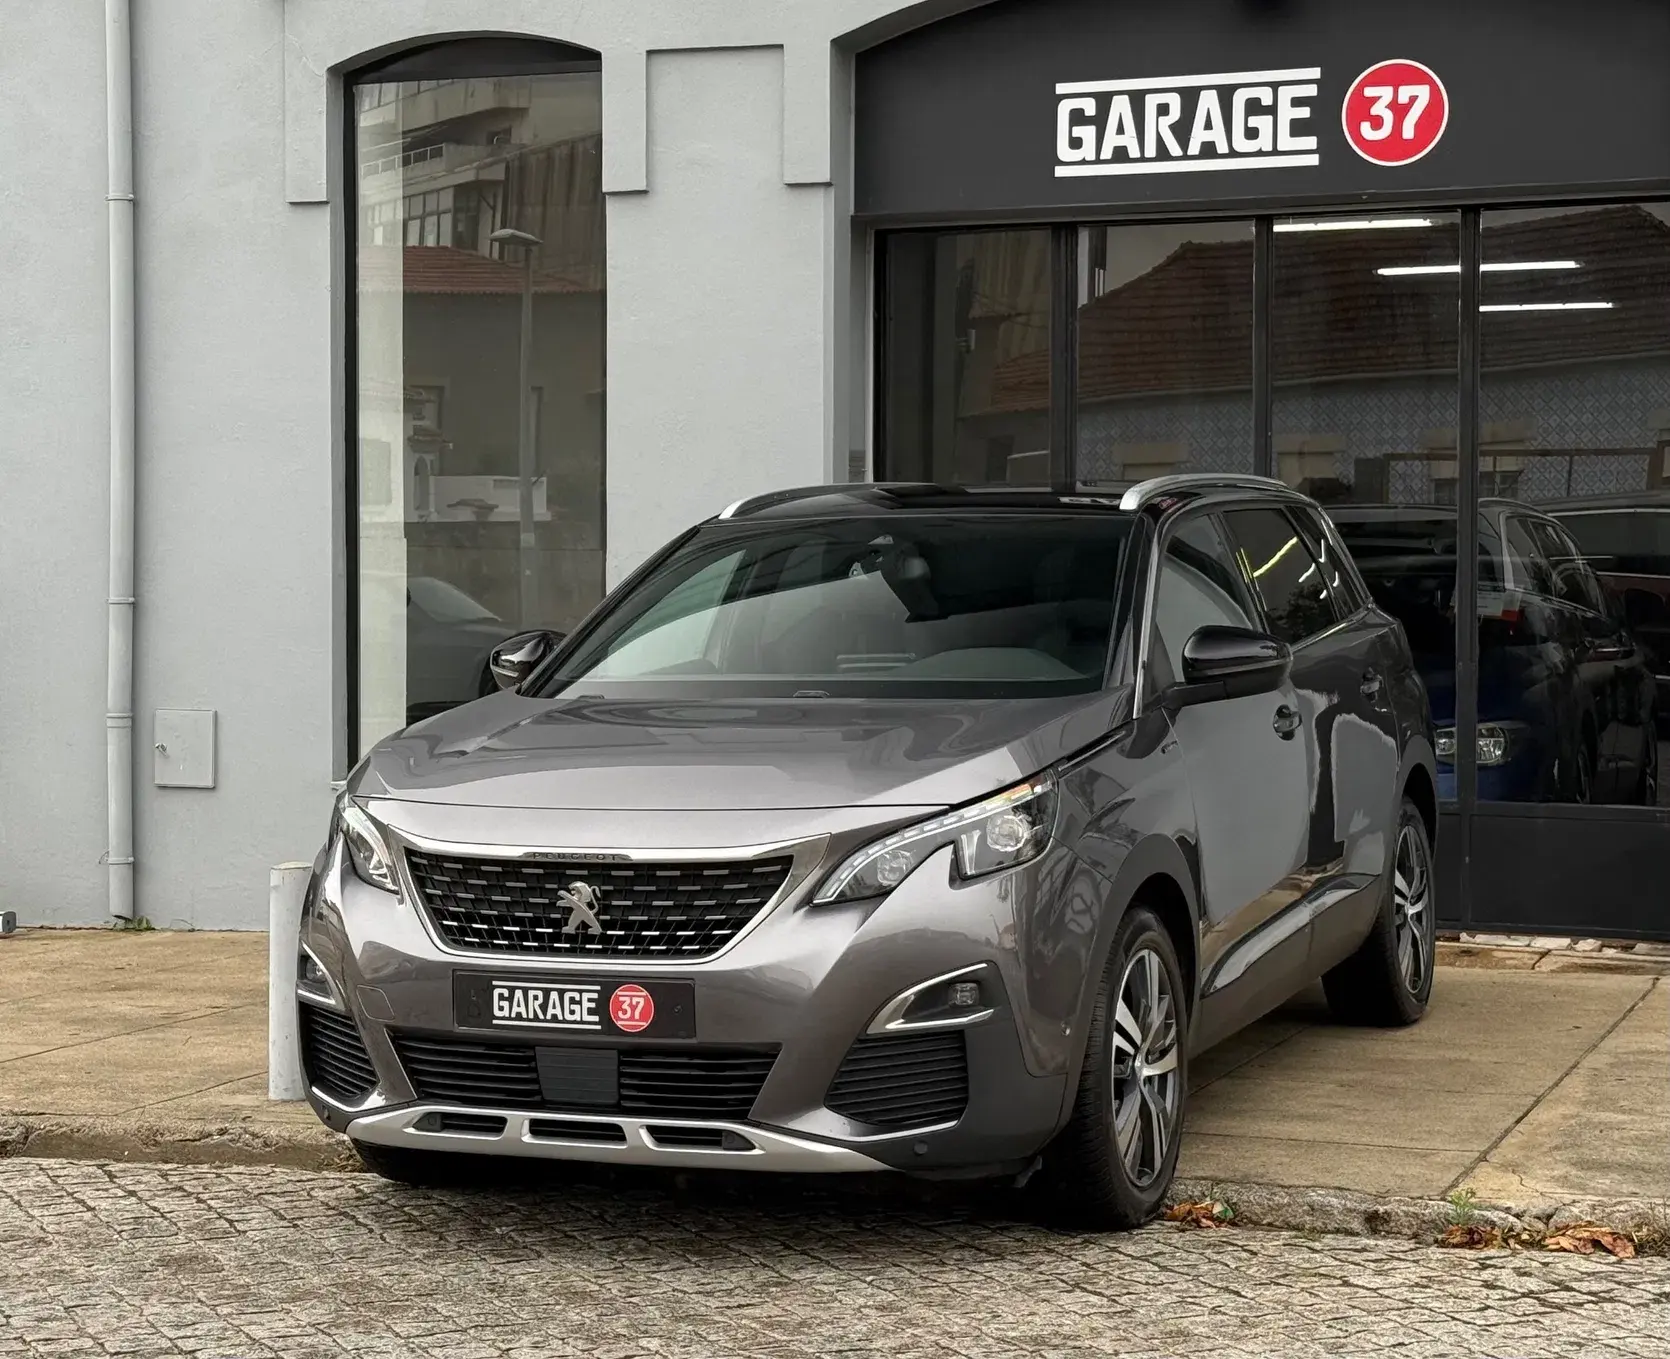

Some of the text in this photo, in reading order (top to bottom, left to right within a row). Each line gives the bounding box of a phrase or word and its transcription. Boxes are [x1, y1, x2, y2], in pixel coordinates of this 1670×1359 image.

[1057, 84, 1430, 162] GARAGE 37
[532, 851, 619, 861] PEUGEOT
[494, 988, 645, 1022] GARAGE 37
